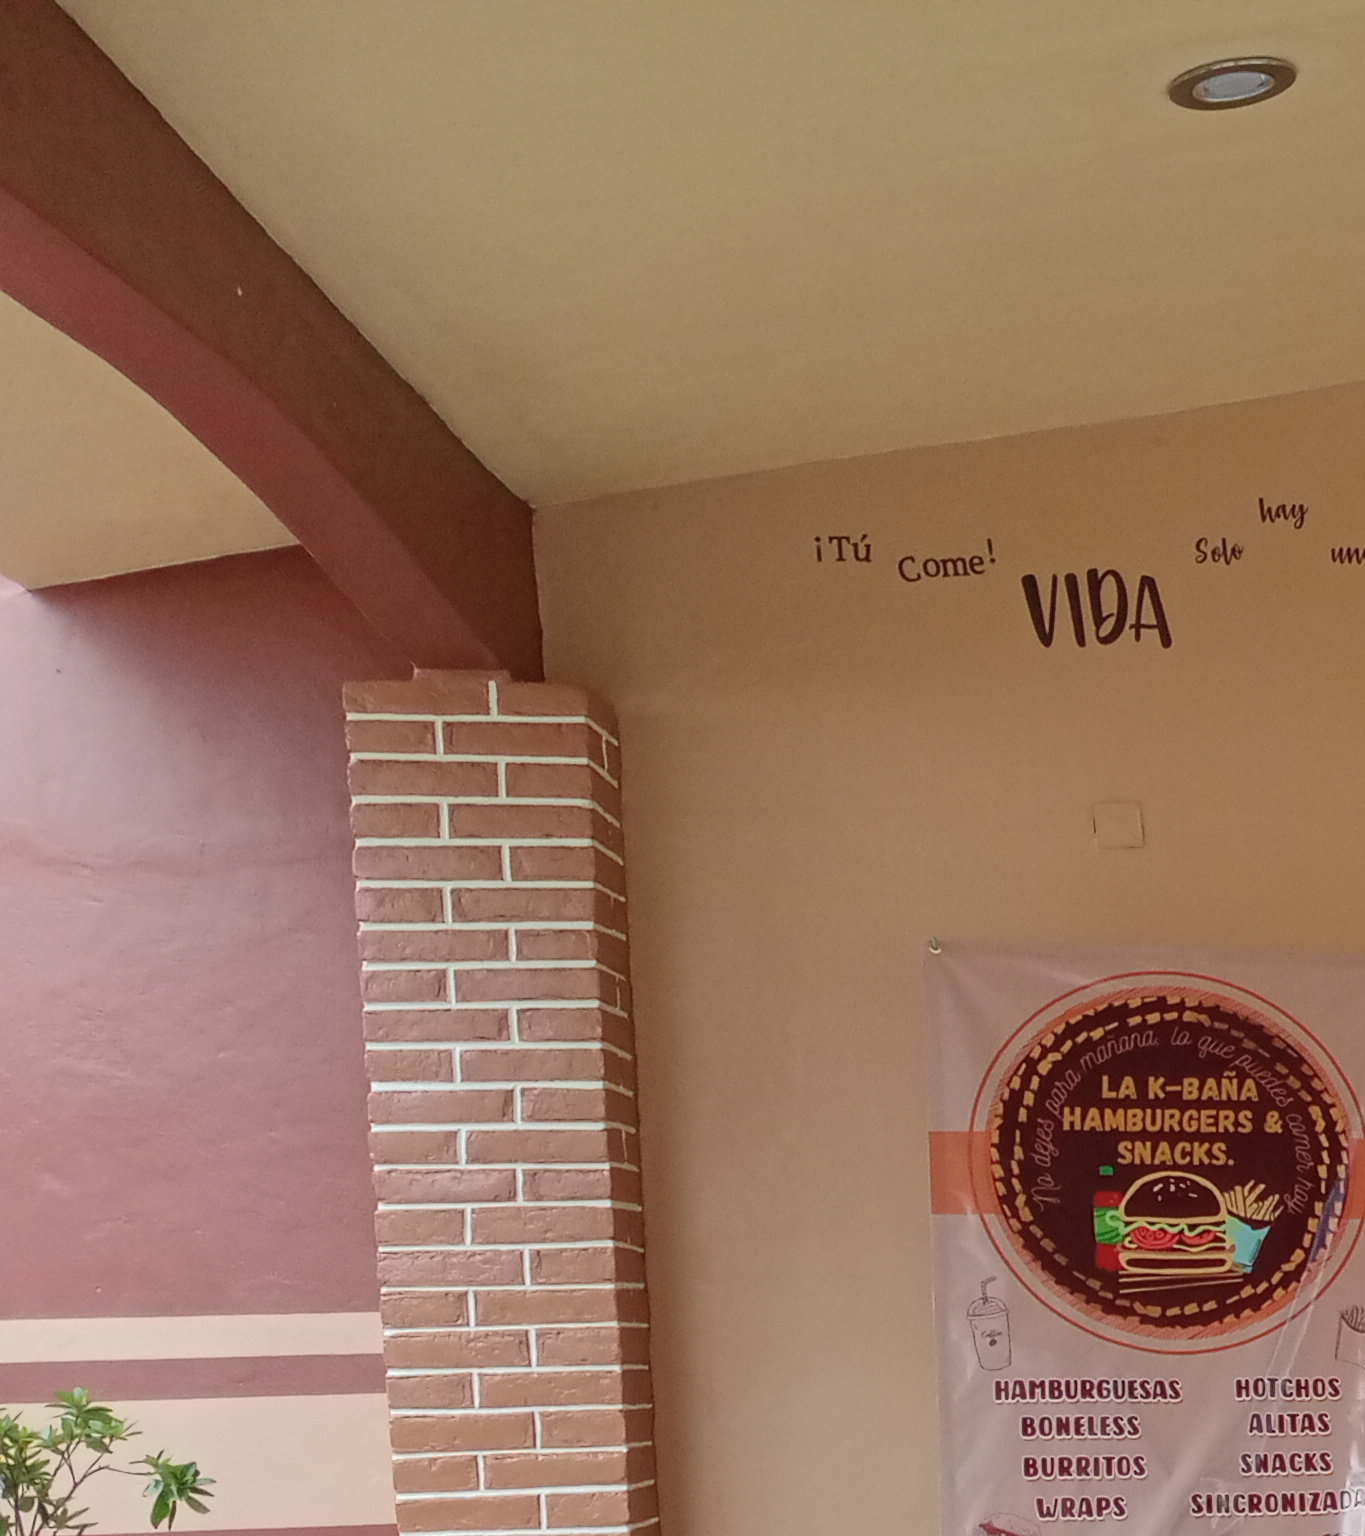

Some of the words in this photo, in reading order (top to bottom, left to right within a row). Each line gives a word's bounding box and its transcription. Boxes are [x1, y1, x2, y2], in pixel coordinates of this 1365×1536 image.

[1194, 536, 1244, 565] Solo
[1258, 497, 1308, 529] hay
[813, 534, 872, 562] ¡Tú
[897, 538, 997, 583] Come!
[1020, 567, 1173, 649] VIDA
[1102, 1075, 1138, 1100] LA
[1148, 1070, 1259, 1102] K-BAÑA
[1030, 1117, 1060, 1168] dejes
[1045, 1068, 1082, 1121] para
[1197, 1034, 1237, 1059] que
[1228, 1053, 1295, 1108] puedes
[1062, 1106, 1254, 1135] HAMBURGERS
[1263, 1110, 1284, 1134] &
[1116, 1140, 1236, 1166] SNACKS.
[994, 1378, 1184, 1404] HAMBURGUESAS
[1235, 1376, 1343, 1400] HOTCHOS
[1020, 1415, 1142, 1440] BONELESS
[1248, 1412, 1332, 1436] ALITAS
[1022, 1455, 1149, 1479] BURRITOS
[1239, 1452, 1334, 1476] SNACKS
[1035, 1496, 1128, 1520] WRAPS
